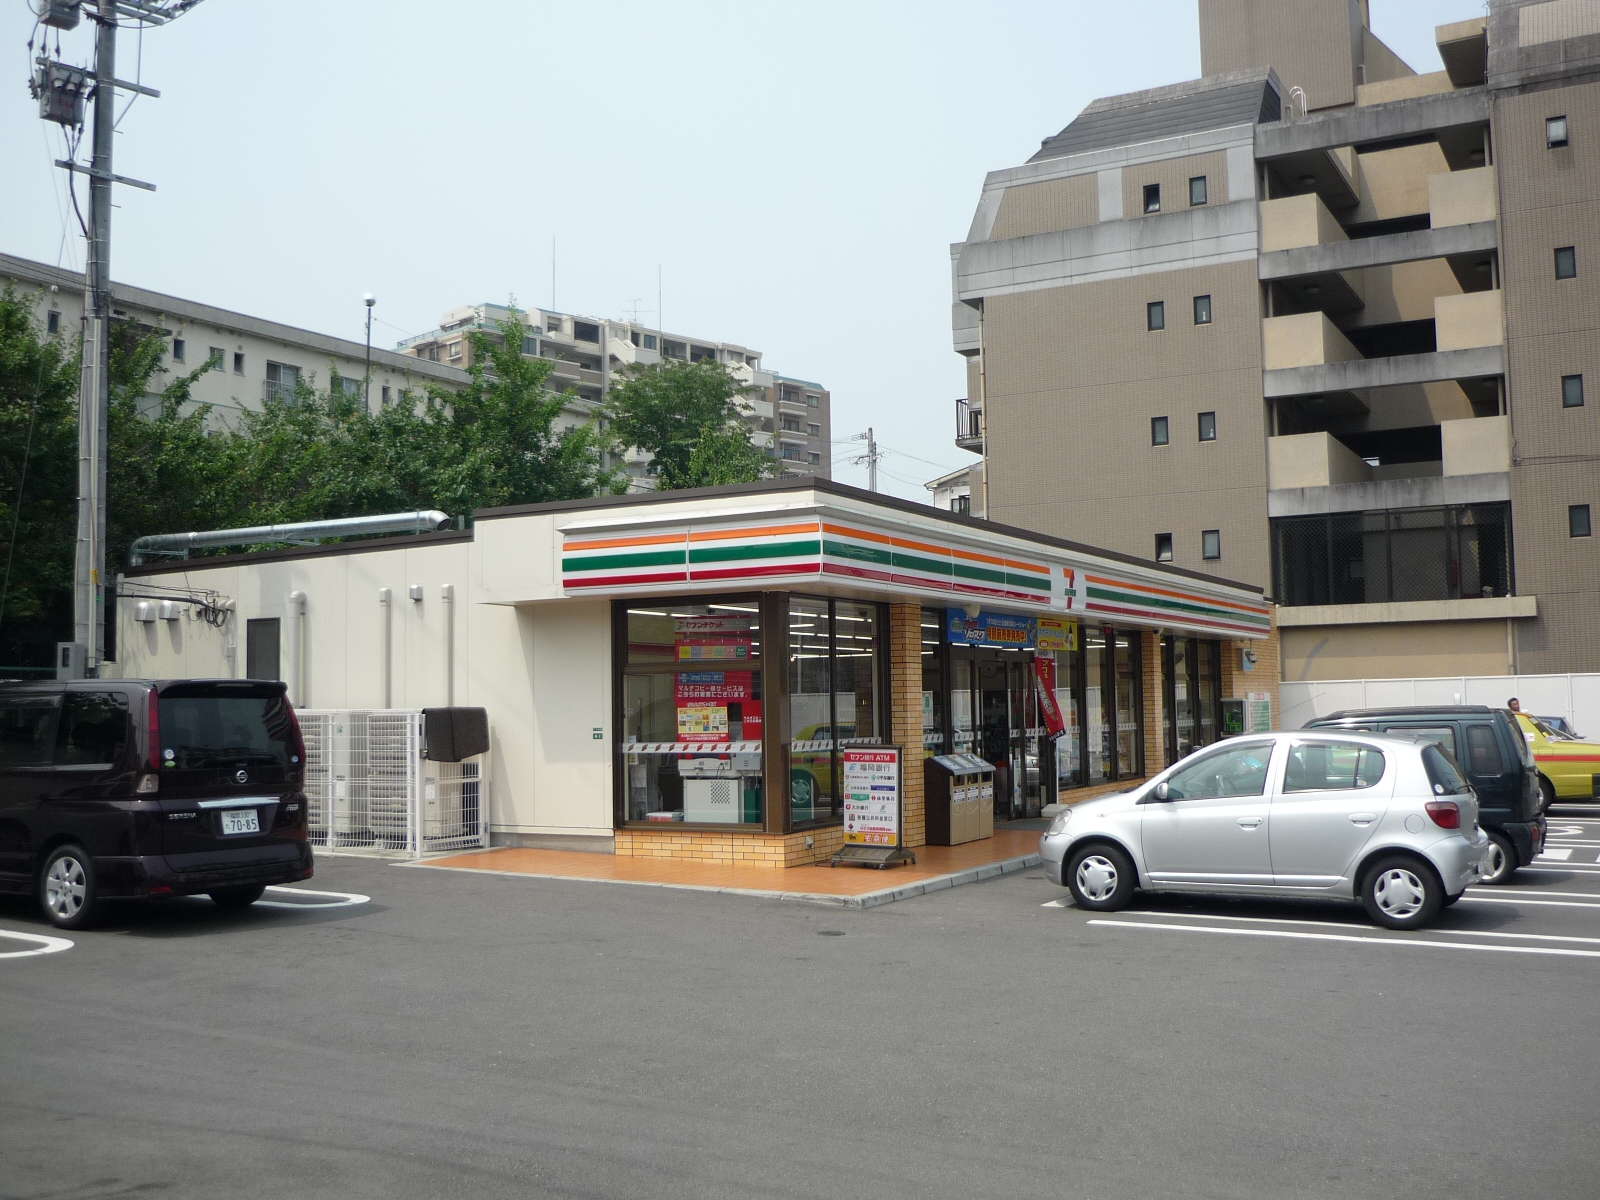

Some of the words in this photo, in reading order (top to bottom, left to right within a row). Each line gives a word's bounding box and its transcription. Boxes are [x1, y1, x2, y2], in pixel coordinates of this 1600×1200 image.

[686, 621, 724, 629] セブンチケット
[860, 763, 891, 772] 福岡銀行
[169, 812, 198, 820] SERENA
